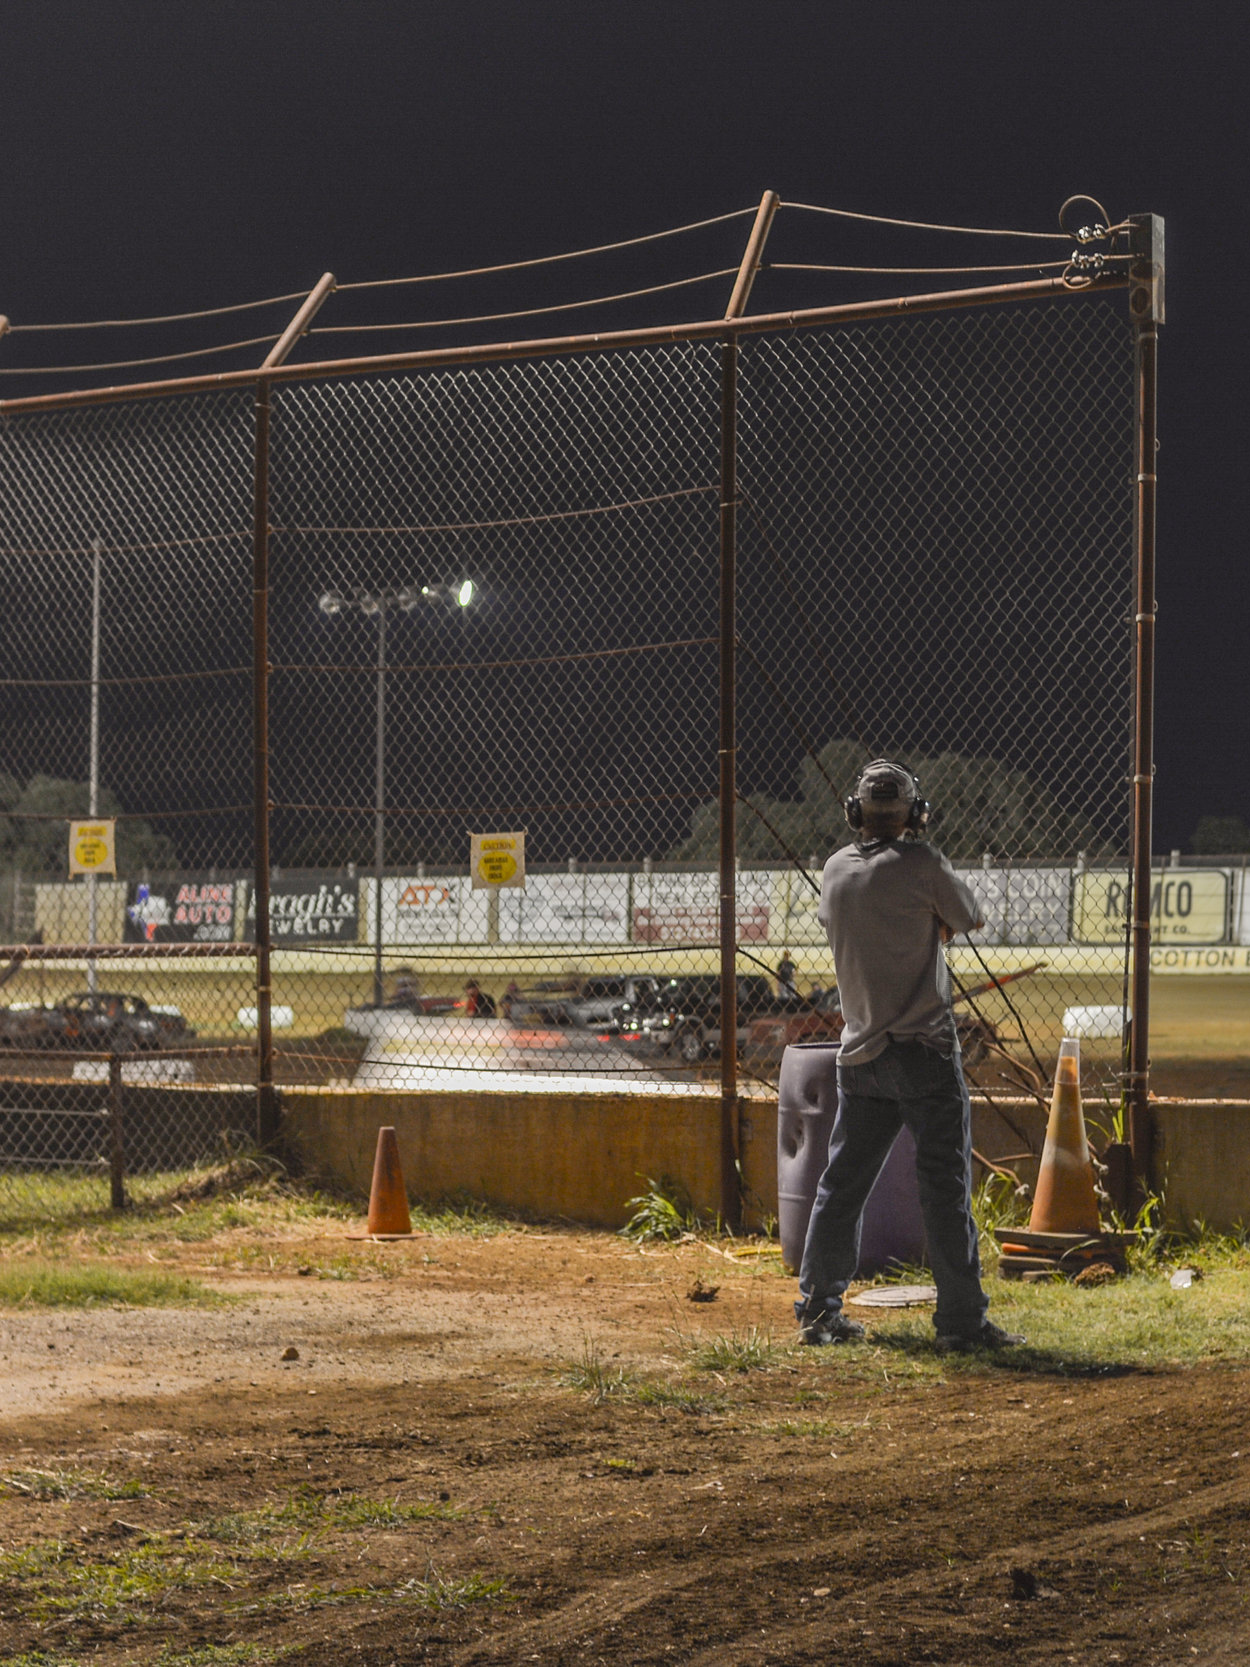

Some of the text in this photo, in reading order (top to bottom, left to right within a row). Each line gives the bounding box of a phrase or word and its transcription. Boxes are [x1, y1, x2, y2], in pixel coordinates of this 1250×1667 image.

[1106, 881, 1192, 918] RMCO
[173, 904, 232, 924] AUTO
[253, 918, 344, 935] EWELRY
[1150, 949, 1236, 967] COTTON
